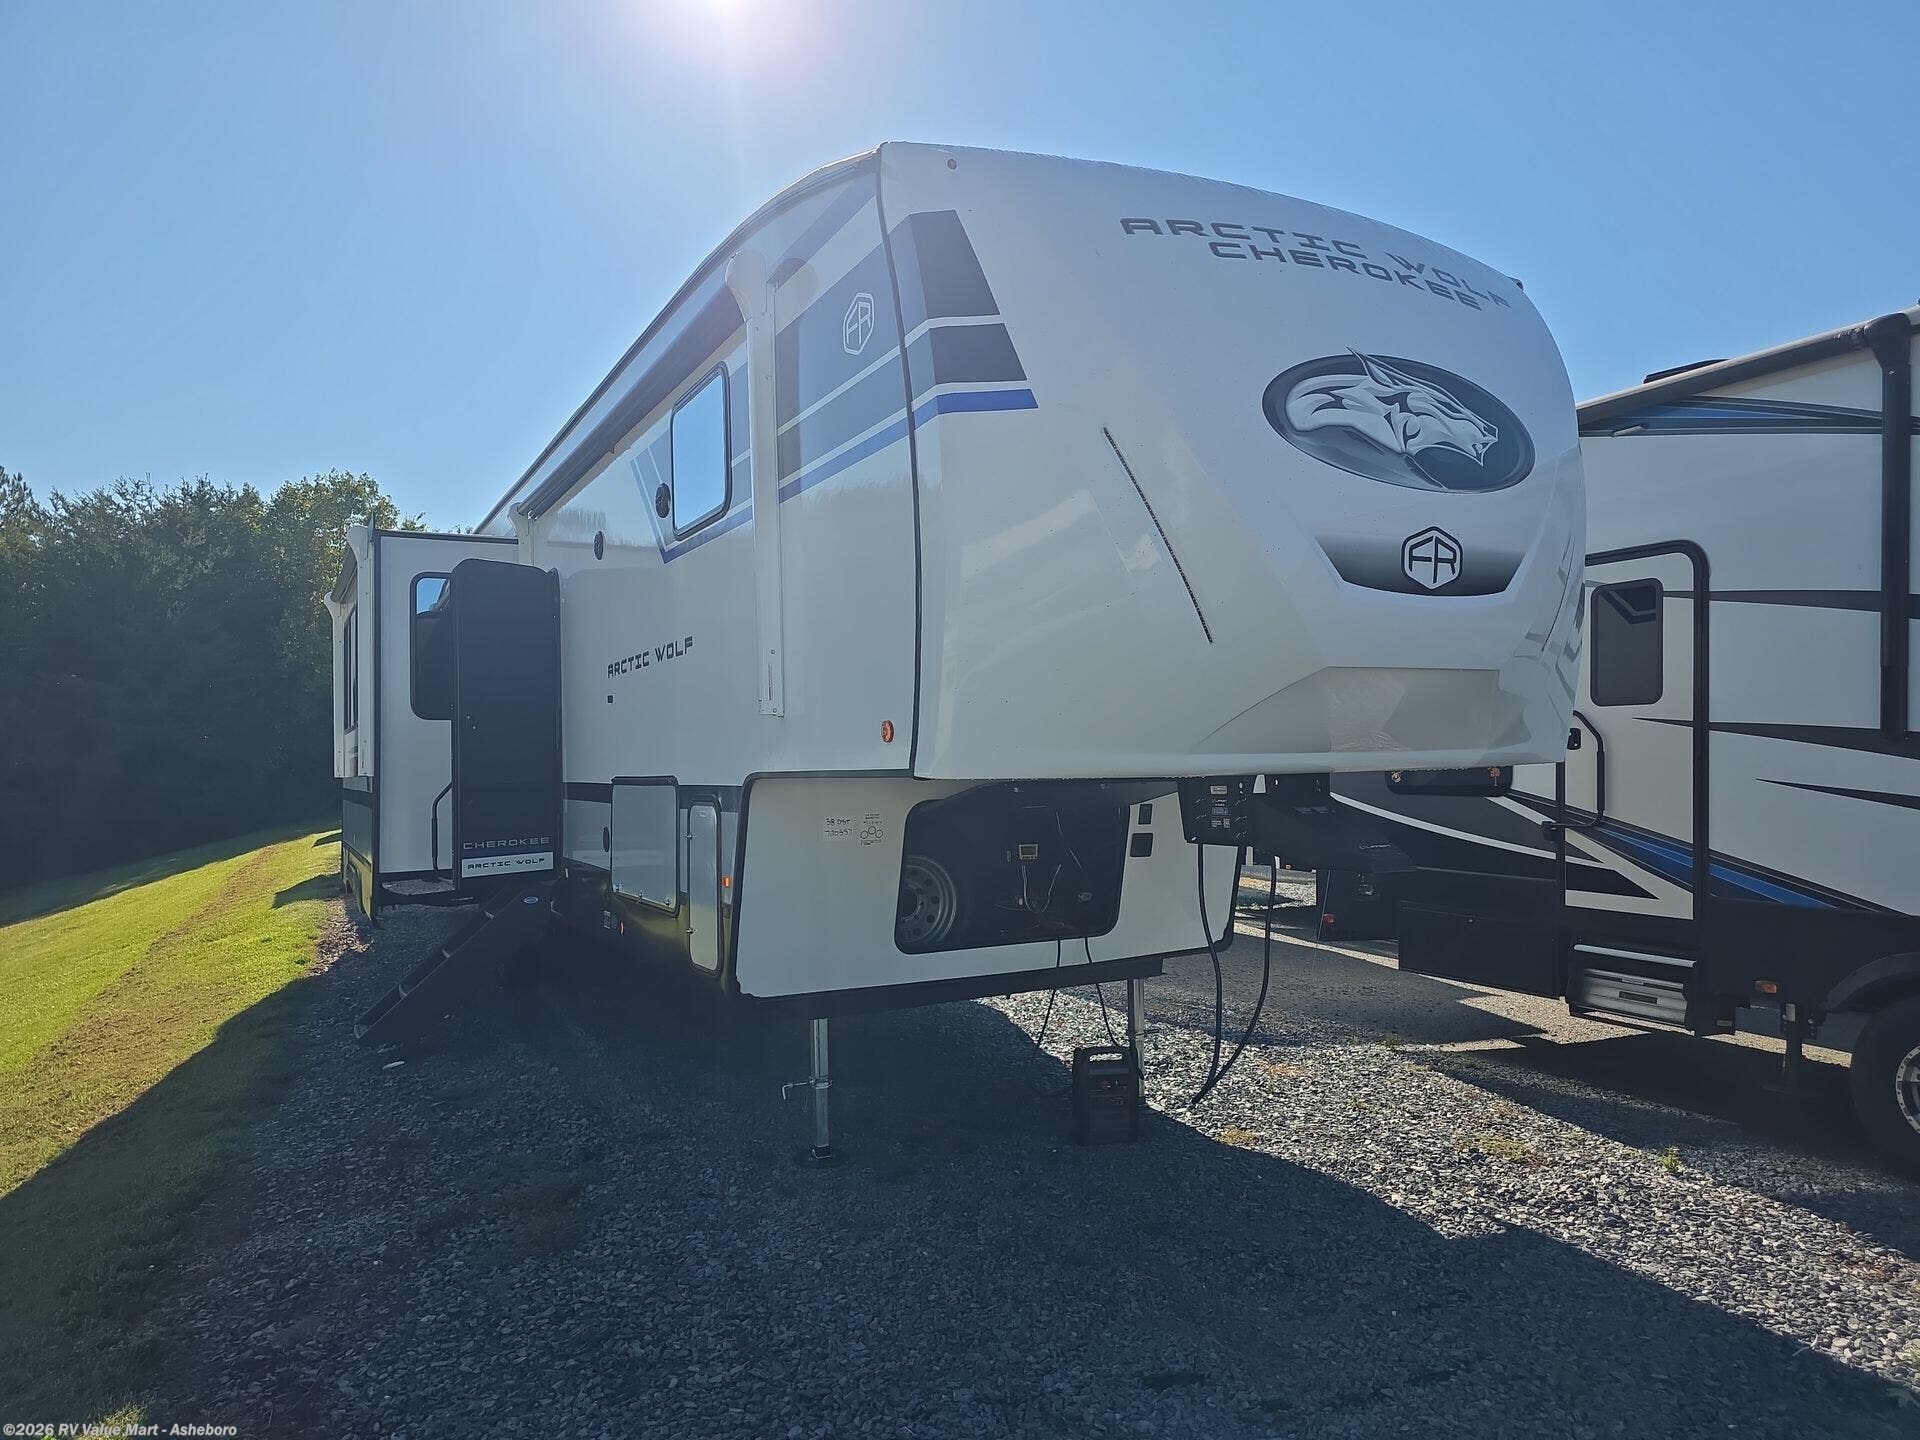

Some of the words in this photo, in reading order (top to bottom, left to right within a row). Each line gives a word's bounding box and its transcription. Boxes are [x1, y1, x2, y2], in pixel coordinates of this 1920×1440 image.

[1120, 218, 1367, 259] ARCTIC
[1384, 252, 1511, 309] WOLF
[1207, 242, 1482, 312] CHEROKEE
[607, 651, 650, 679] ARCTIC
[654, 635, 693, 662] WOLF
[463, 836, 550, 850] CHEROKEE
[467, 860, 511, 870] ARCTIC
